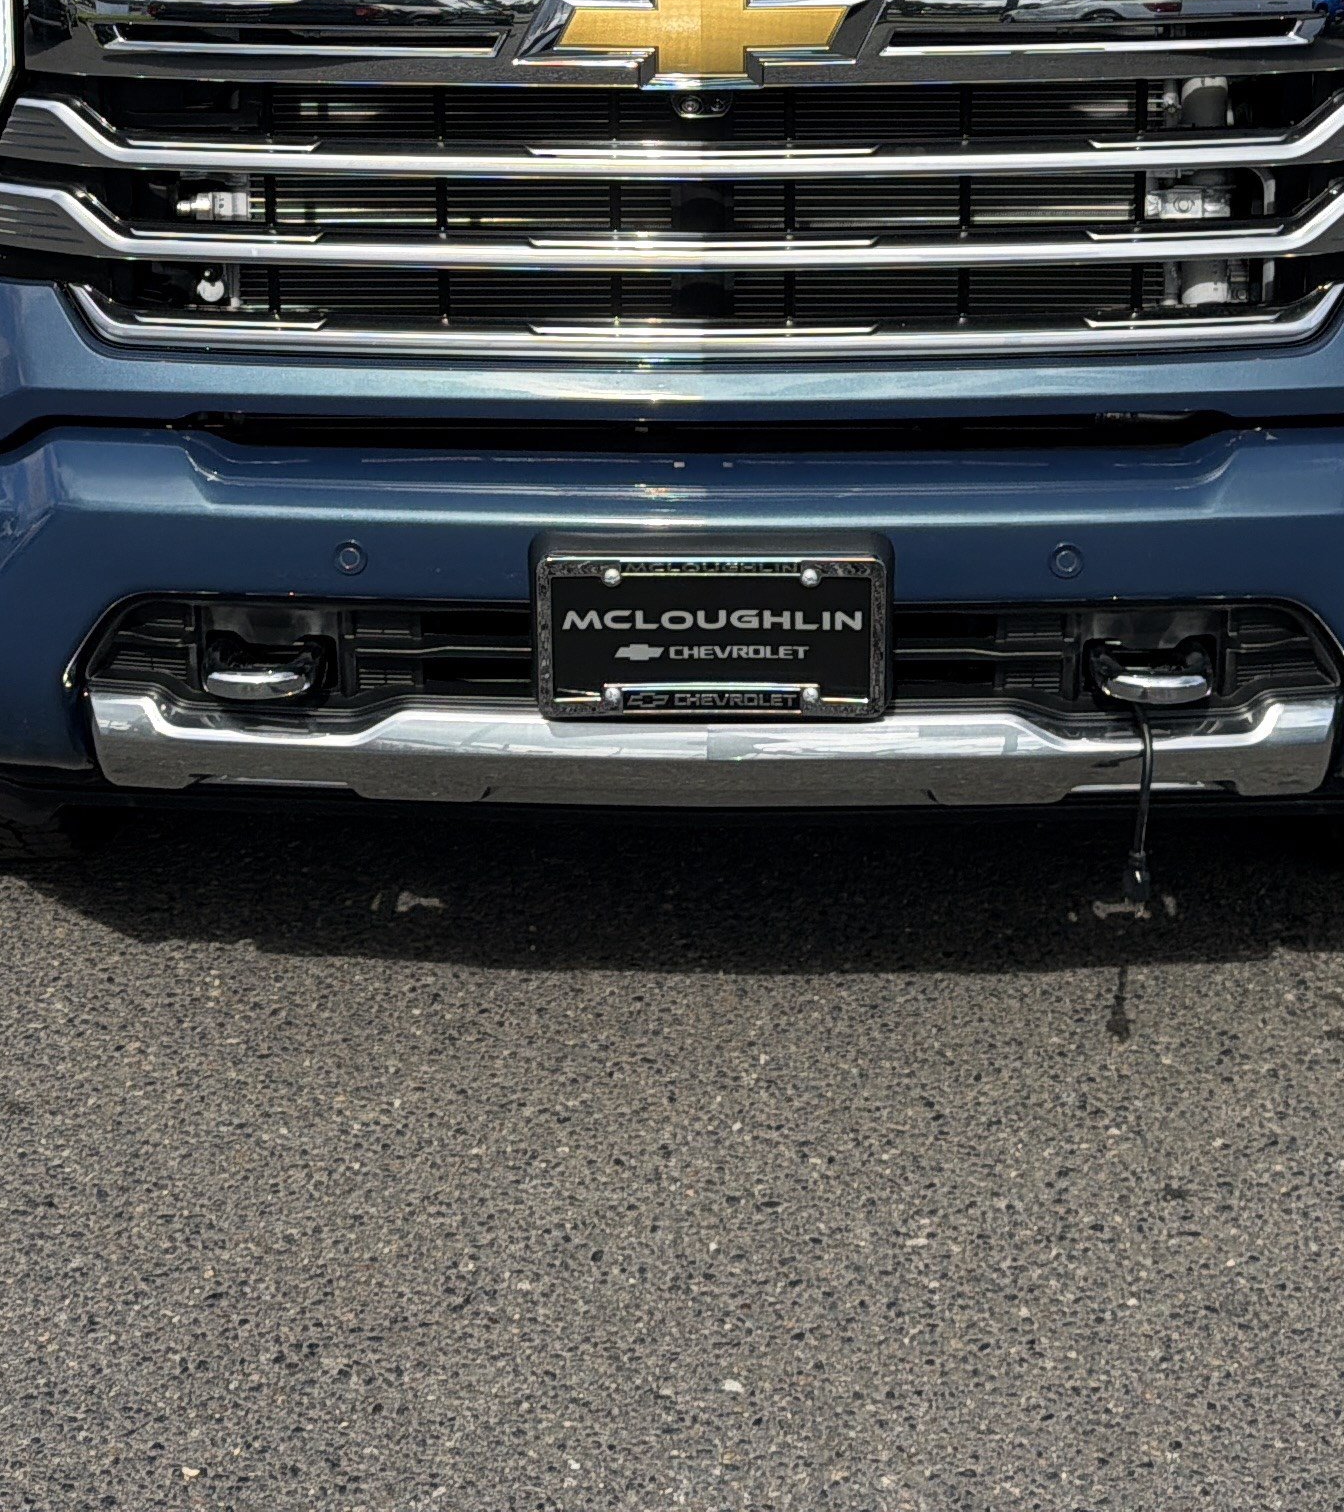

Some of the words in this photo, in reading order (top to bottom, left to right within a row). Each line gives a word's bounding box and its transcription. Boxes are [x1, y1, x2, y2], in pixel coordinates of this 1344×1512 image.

[561, 609, 864, 631] MCLOUGHLIN
[669, 645, 810, 659] CHEVROLET
[673, 692, 798, 707] CHEVROLET
